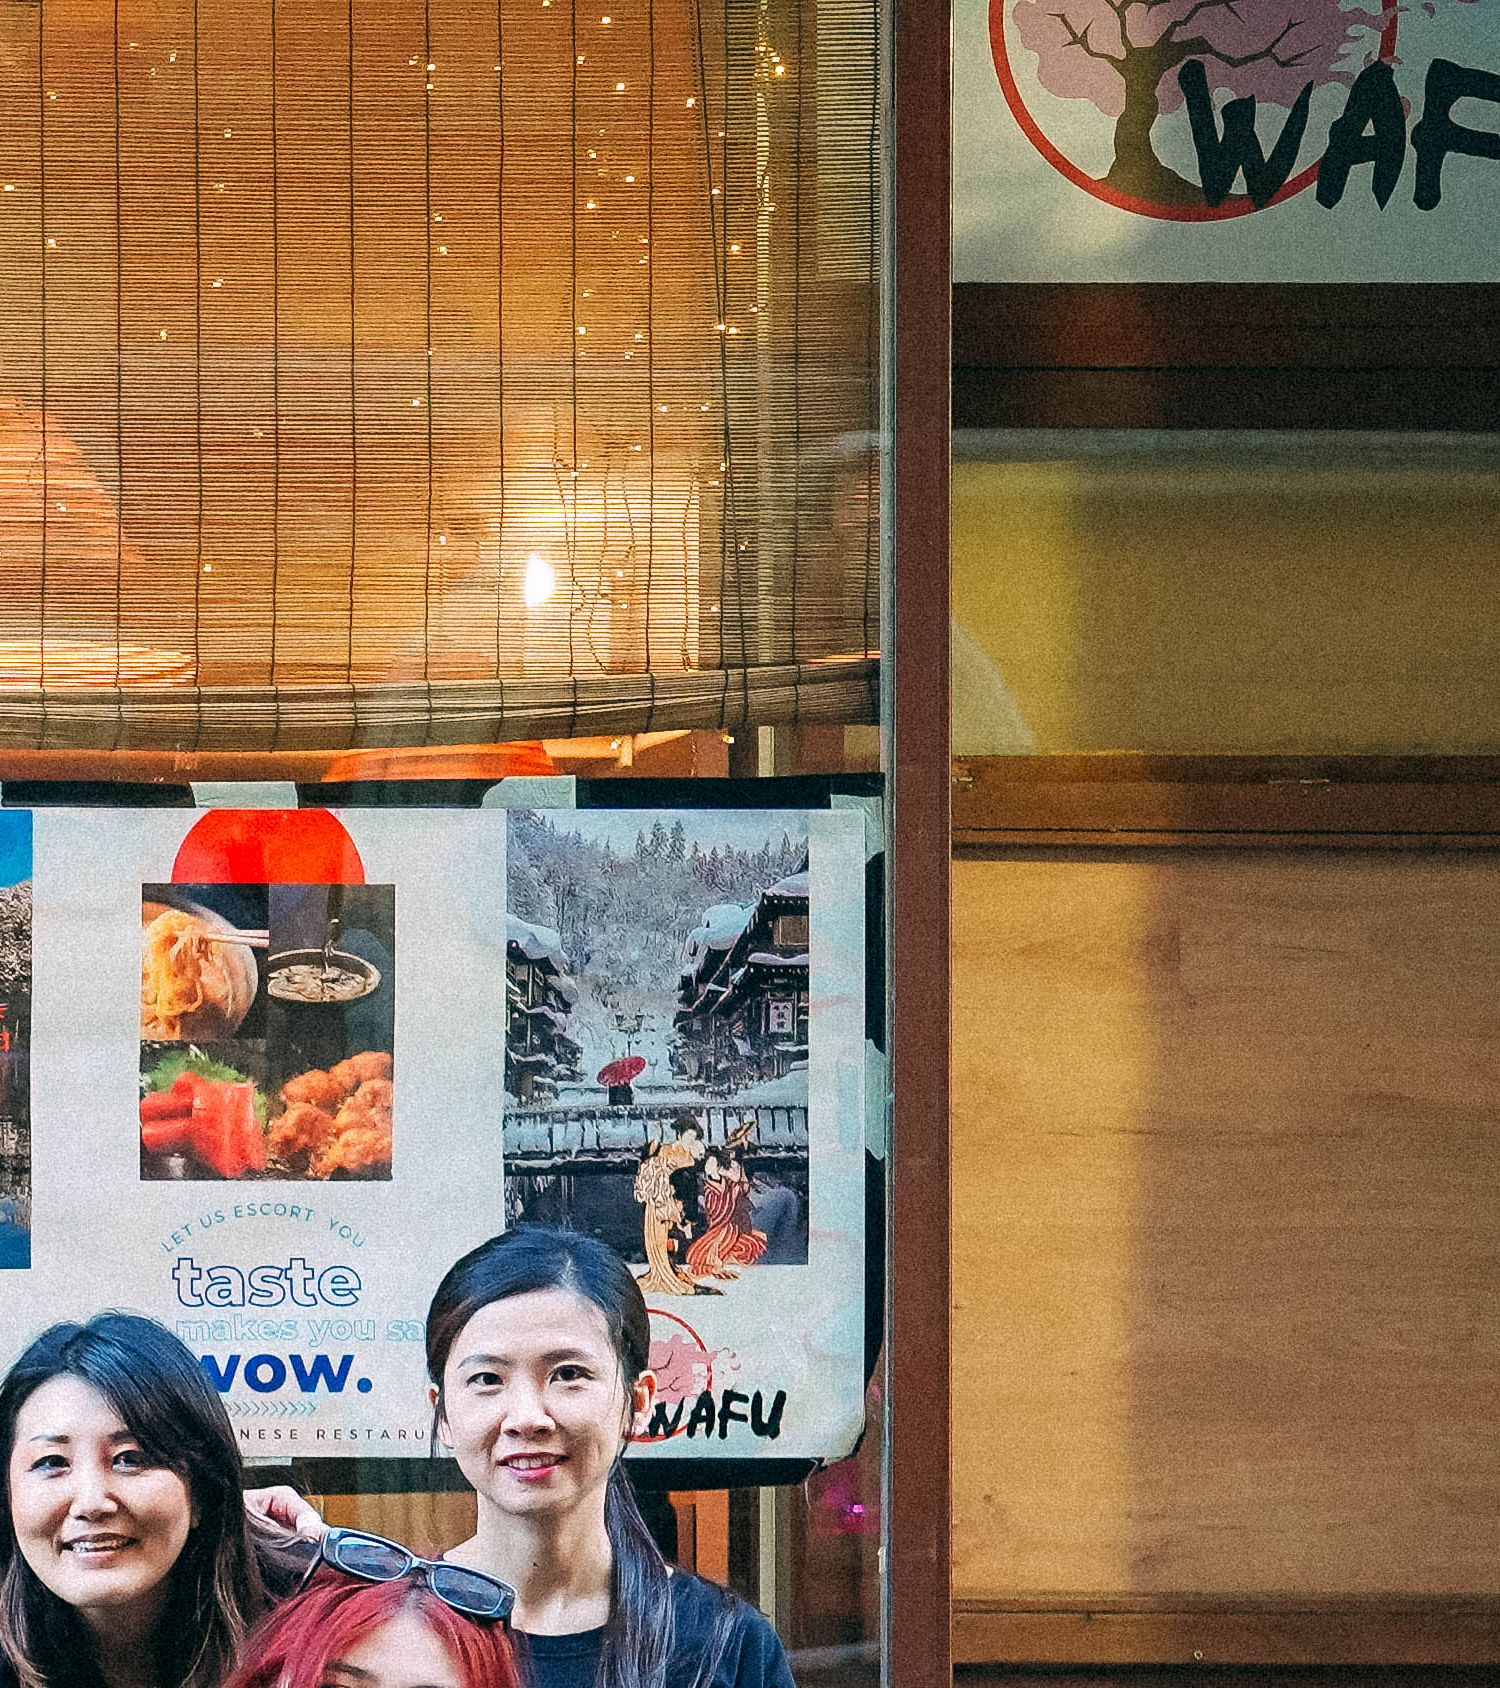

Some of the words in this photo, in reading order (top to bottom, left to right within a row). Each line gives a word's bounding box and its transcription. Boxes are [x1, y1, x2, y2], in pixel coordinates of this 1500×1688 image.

[1177, 59, 1500, 211] WAF
[161, 1223, 193, 1252] LET
[199, 1209, 226, 1229] US
[233, 1202, 316, 1222] ESCORT
[329, 1216, 367, 1248] YOU
[171, 1257, 362, 1308] taste
[175, 1313, 299, 1342] makes
[308, 1319, 376, 1348] you
[386, 1319, 425, 1342] sa
[240, 1428, 299, 1441] NESE
[317, 1428, 425, 1441] RESTARU
